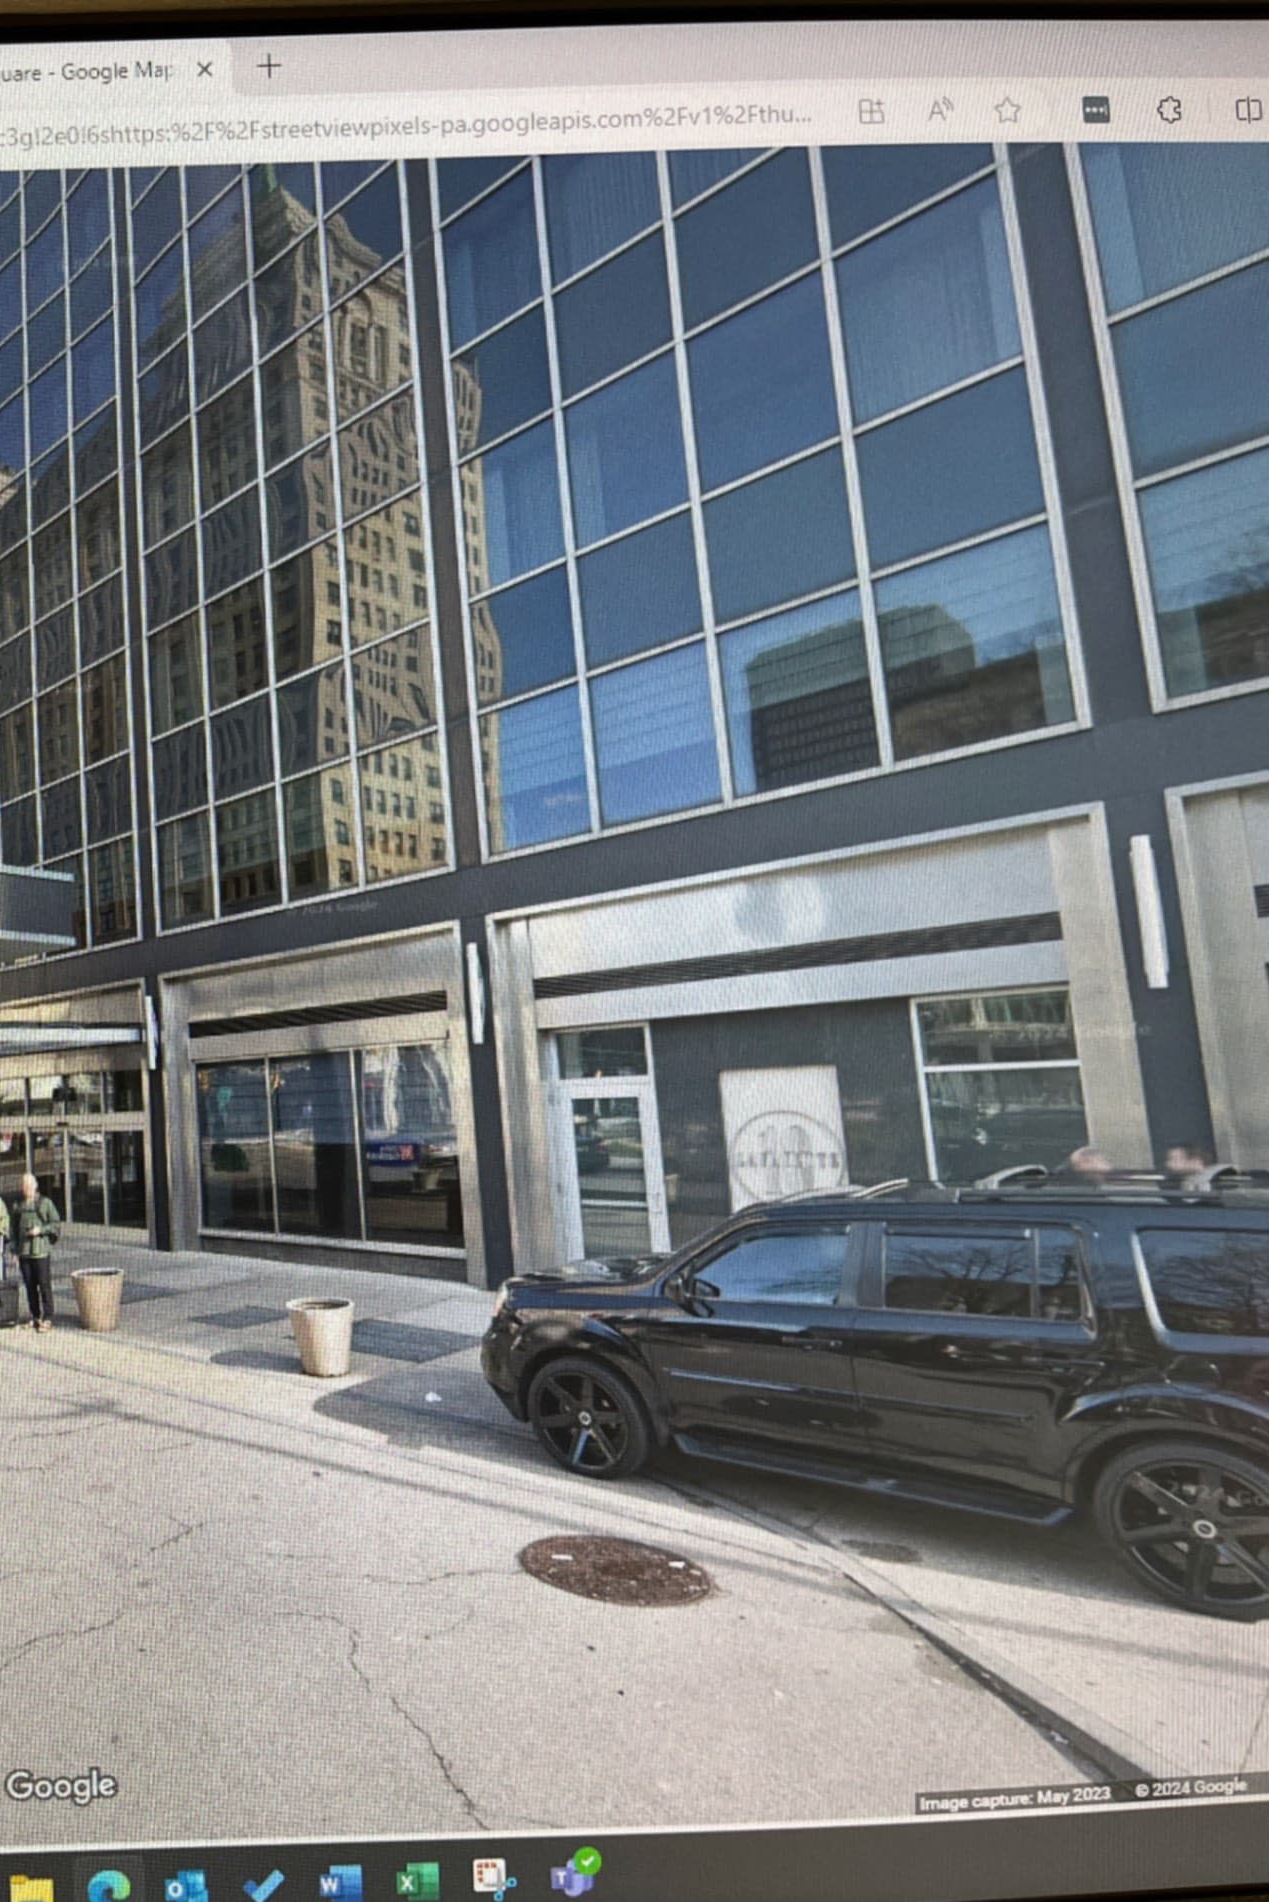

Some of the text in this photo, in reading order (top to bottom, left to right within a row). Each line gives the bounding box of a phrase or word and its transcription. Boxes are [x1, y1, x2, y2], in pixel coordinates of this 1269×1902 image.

[61, 62, 129, 84] Google
[5, 1767, 118, 1806] Google
[920, 1796, 969, 1812] Image
[971, 1792, 1034, 1811] capture:
[1037, 1789, 1070, 1805] May
[1073, 1786, 1111, 1801] 2023
[1153, 1781, 1190, 1797] 2024
[1194, 1777, 1248, 1795] Google
